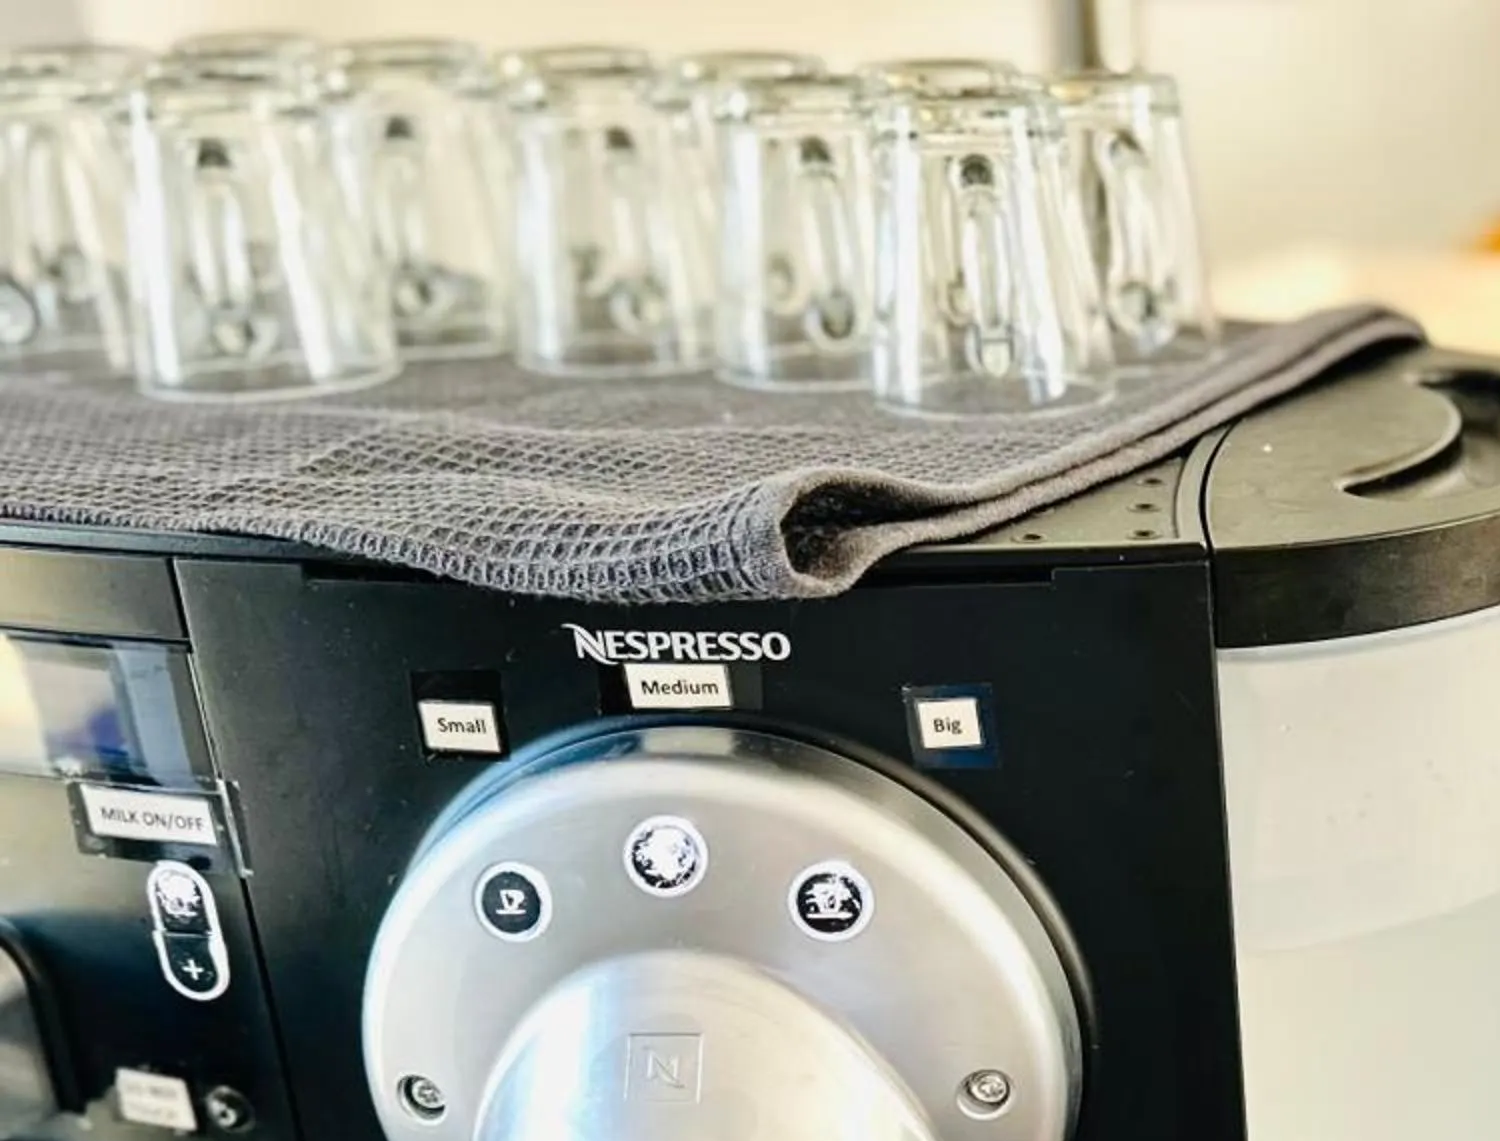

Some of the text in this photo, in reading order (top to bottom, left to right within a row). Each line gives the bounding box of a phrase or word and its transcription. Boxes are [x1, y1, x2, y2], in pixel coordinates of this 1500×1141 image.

[561, 623, 791, 665] NESPRESSO
[641, 679, 719, 695] Medium
[437, 717, 487, 734] Small
[933, 716, 963, 735] Big
[100, 806, 204, 831] MILK ON/OFF
